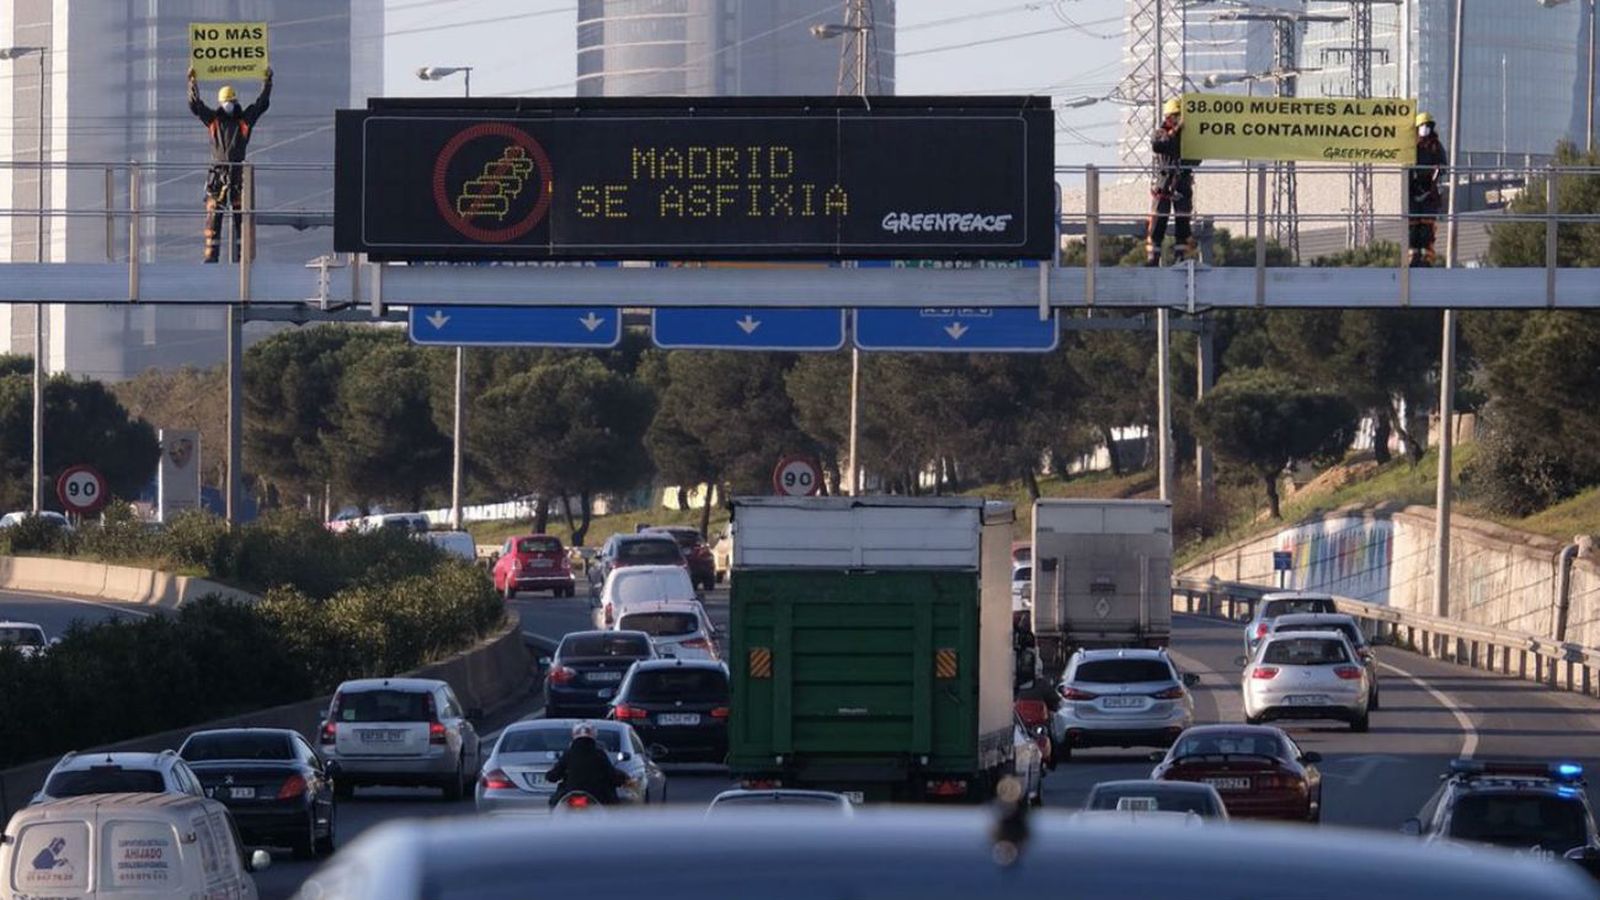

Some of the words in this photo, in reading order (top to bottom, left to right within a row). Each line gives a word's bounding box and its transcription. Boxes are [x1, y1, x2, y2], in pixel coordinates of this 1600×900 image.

[194, 29, 219, 41] NO
[225, 26, 263, 40] MÁS
[193, 47, 265, 59] COCHES
[1186, 100, 1244, 114] 38.000
[1249, 100, 1337, 116] MUERTES
[1343, 101, 1367, 116] AL
[1372, 100, 1411, 117] AÑO
[1199, 122, 1236, 136] POR
[1242, 121, 1397, 138] CONTAMINACIÓN
[1322, 146, 1400, 159] GREENPEACE
[632, 147, 794, 179] MADRID
[577, 184, 628, 218] SE
[660, 184, 849, 217] ASFIXIA
[881, 211, 1013, 235] GREENPEACE
[784, 471, 812, 488] 90
[68, 481, 96, 497] 90
